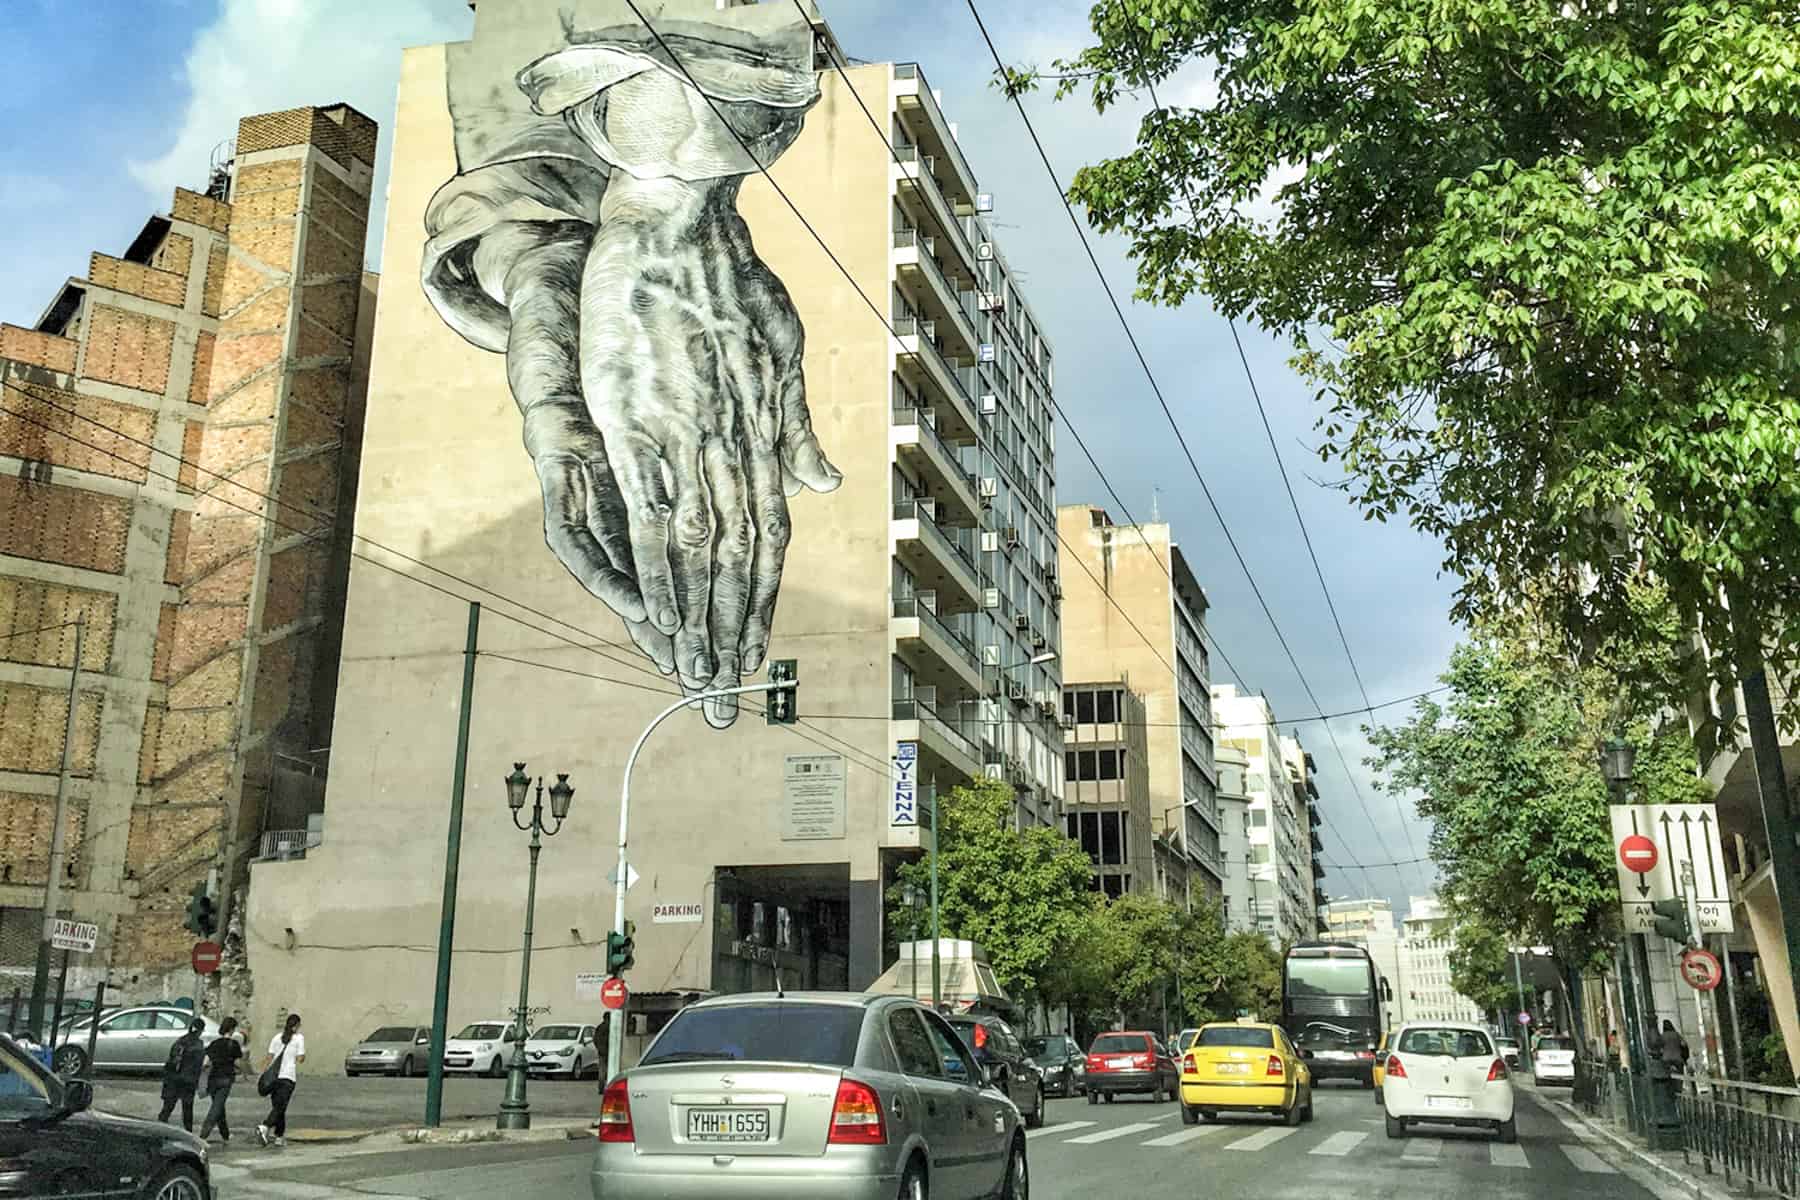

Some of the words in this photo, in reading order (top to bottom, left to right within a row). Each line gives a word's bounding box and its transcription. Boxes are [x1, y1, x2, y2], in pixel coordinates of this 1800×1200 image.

[895, 761, 913, 822] VIENNA
[654, 904, 702, 917] PARKING
[54, 922, 96, 940] ARKING
[693, 1114, 719, 1132] YHH
[728, 1114, 765, 1132] 1655
